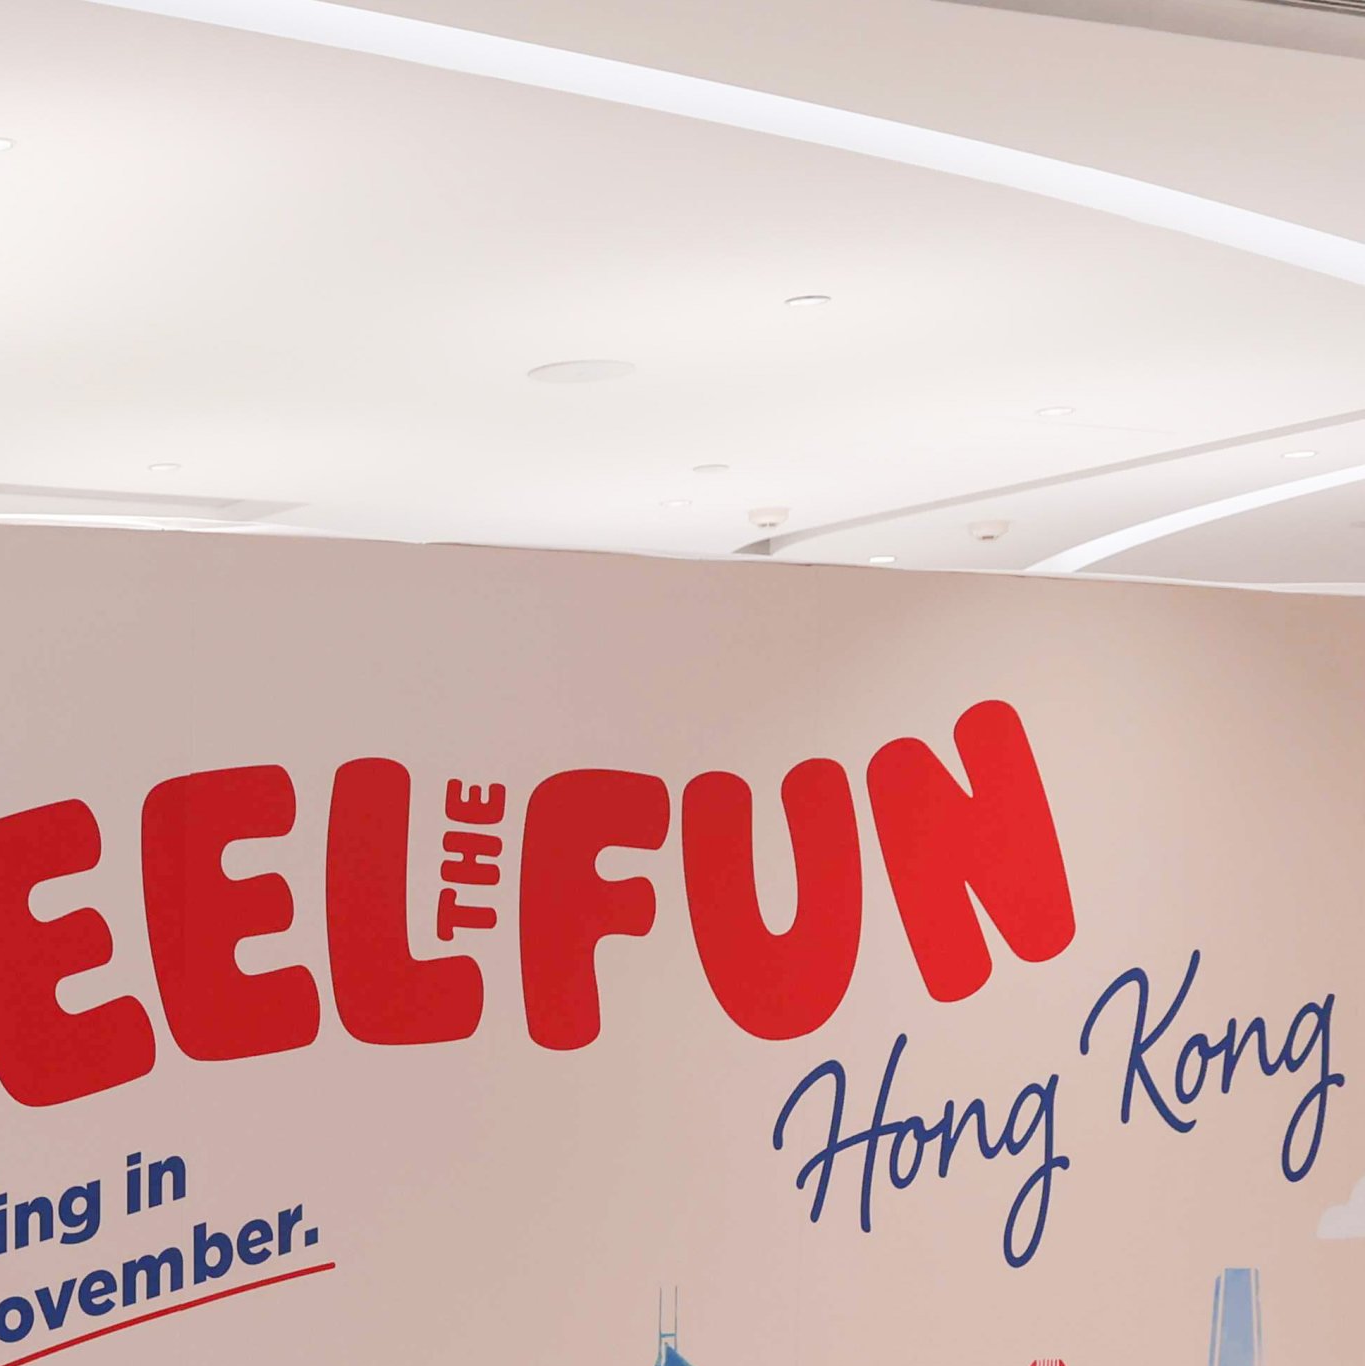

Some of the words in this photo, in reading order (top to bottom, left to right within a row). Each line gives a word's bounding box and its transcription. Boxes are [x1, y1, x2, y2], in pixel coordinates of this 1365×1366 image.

[436, 778, 507, 942] THE
[518, 698, 1077, 1052] FUN
[126, 1151, 186, 1215] in
[772, 1033, 1071, 1269] Hong
[1079, 950, 1346, 1184] Kong
